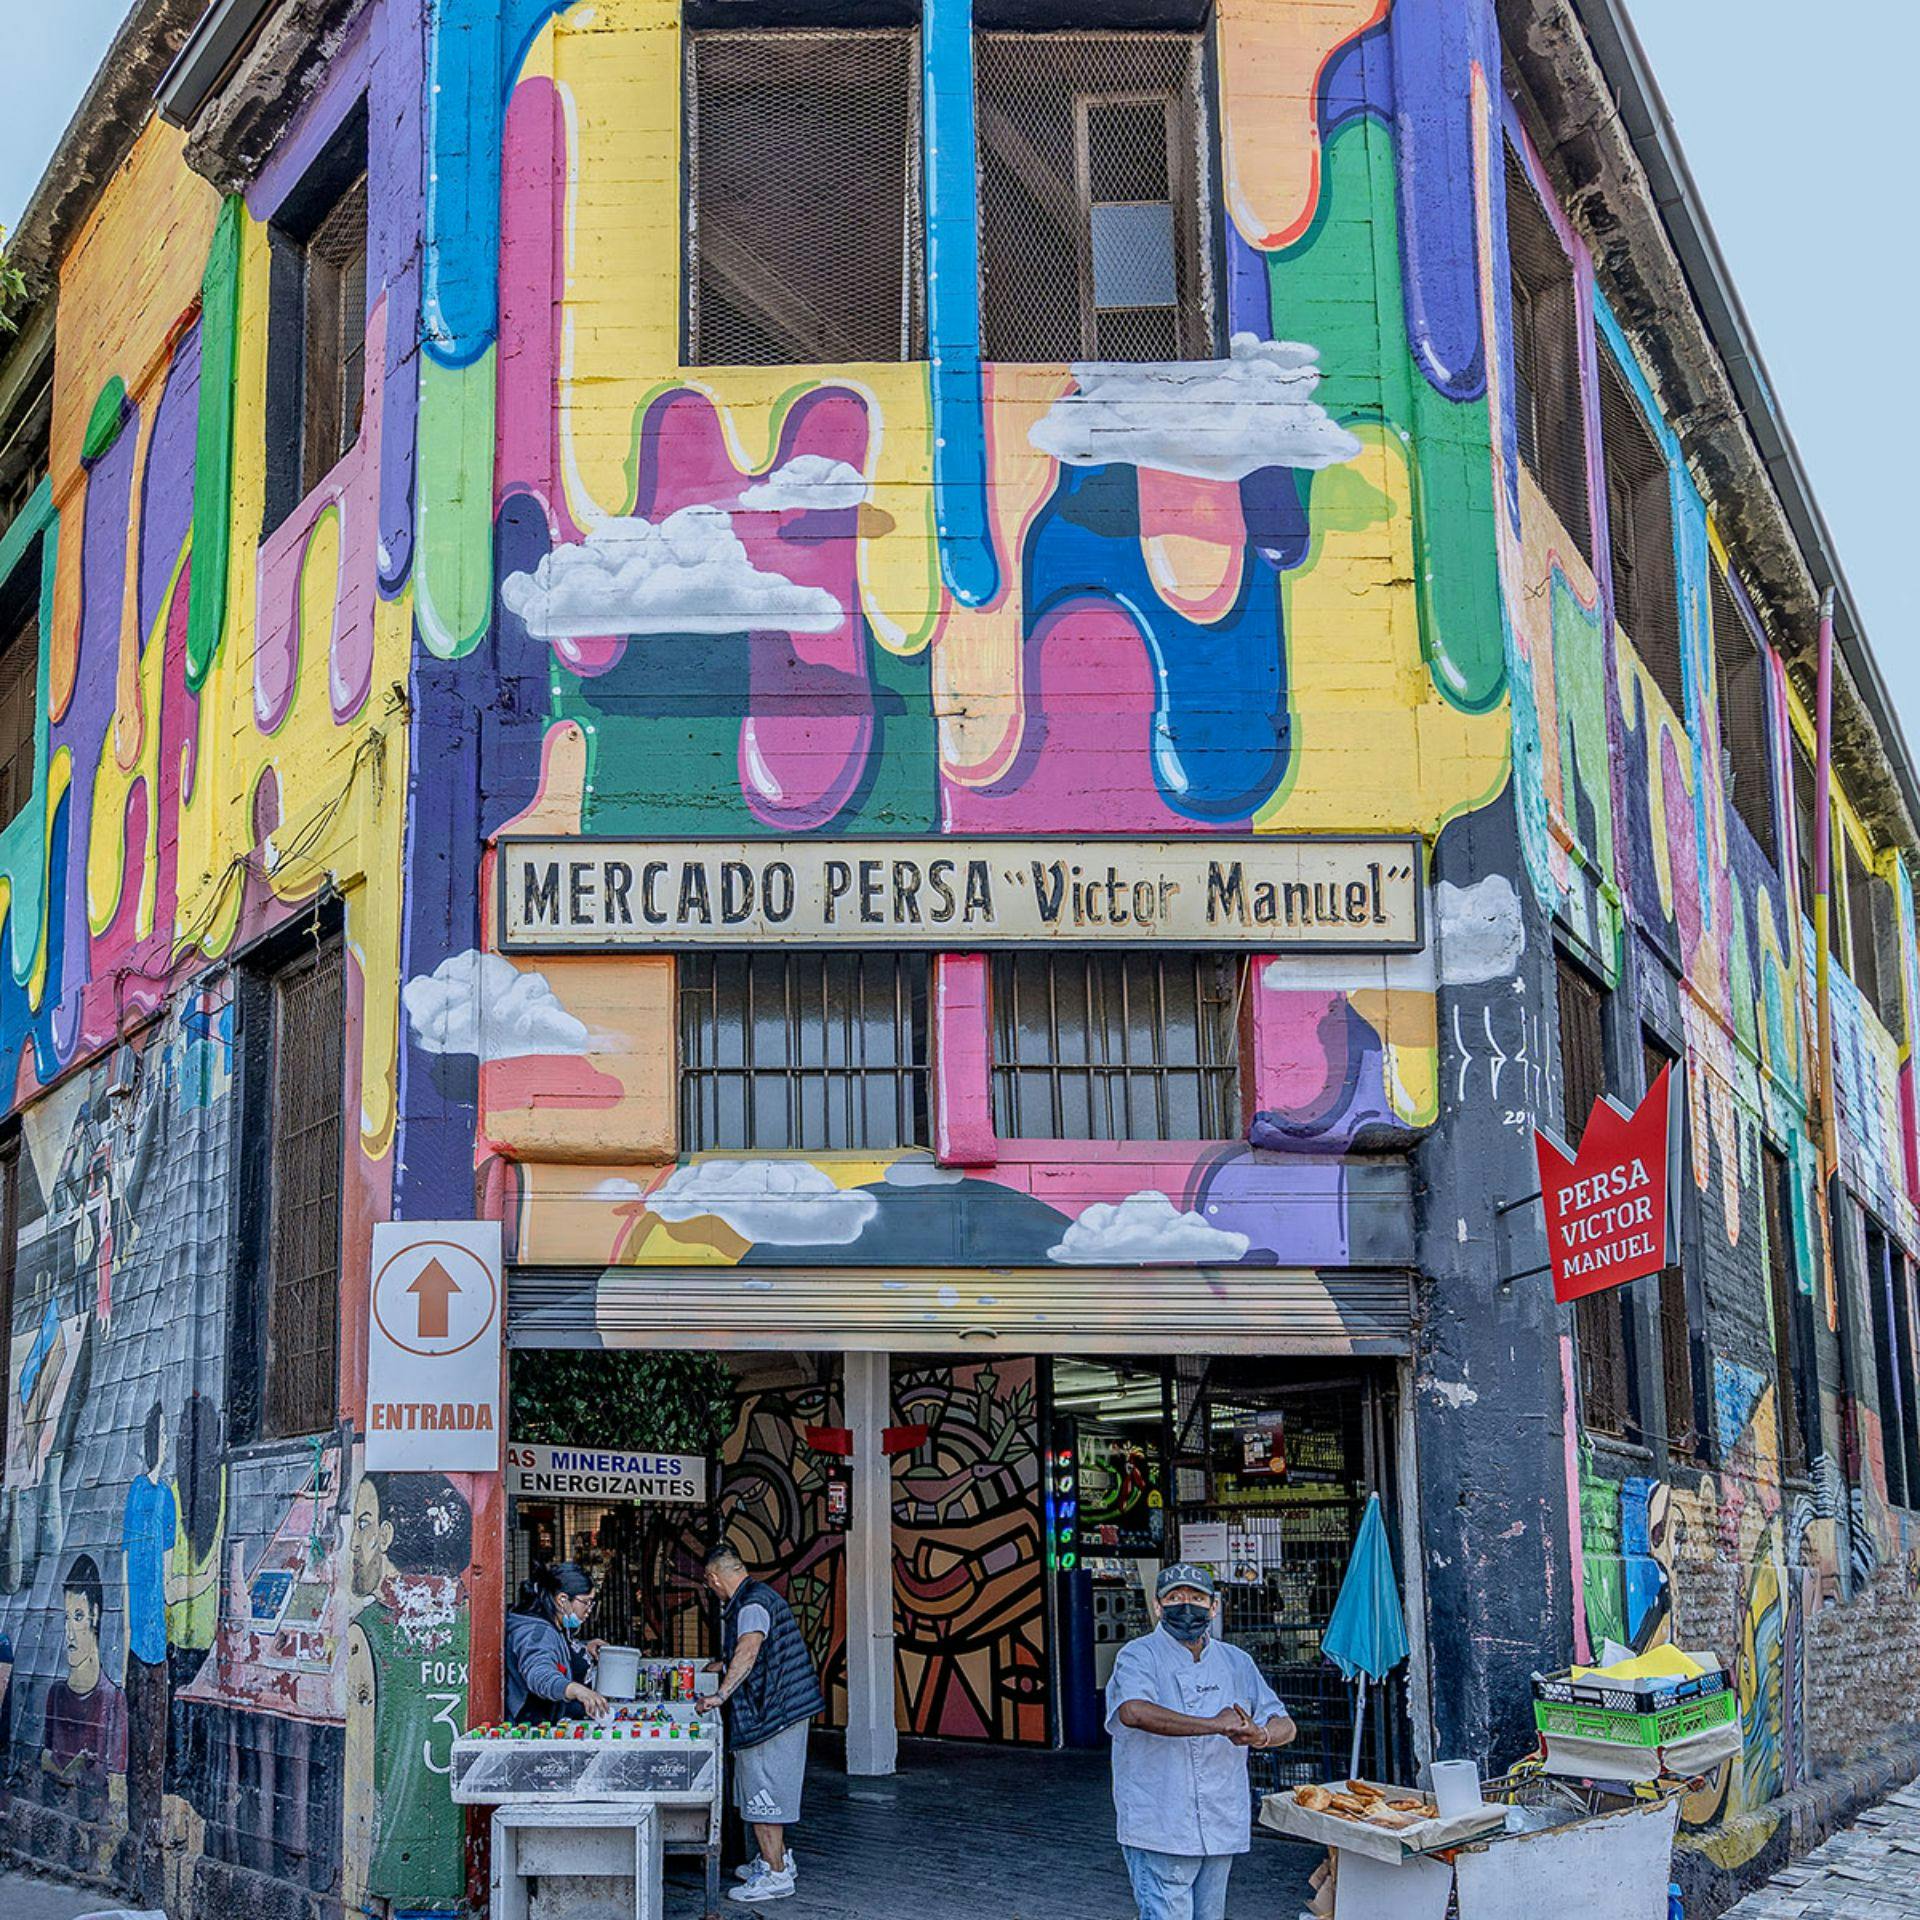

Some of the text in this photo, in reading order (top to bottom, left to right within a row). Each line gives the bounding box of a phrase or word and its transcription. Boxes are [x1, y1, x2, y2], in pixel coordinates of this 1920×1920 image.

[523, 861, 794, 924] MERCADO
[823, 860, 993, 924] PERSA
[1558, 1158, 1650, 1217] PERSA
[1561, 1196, 1653, 1248] VICTOR
[1562, 1232, 1656, 1279] MANUEL
[372, 1403, 493, 1430] ENTRADA
[551, 1451, 682, 1476] MINERALES
[521, 1473, 695, 1497] ENERGIZANTES
[1164, 1565, 1202, 1582] NYC
